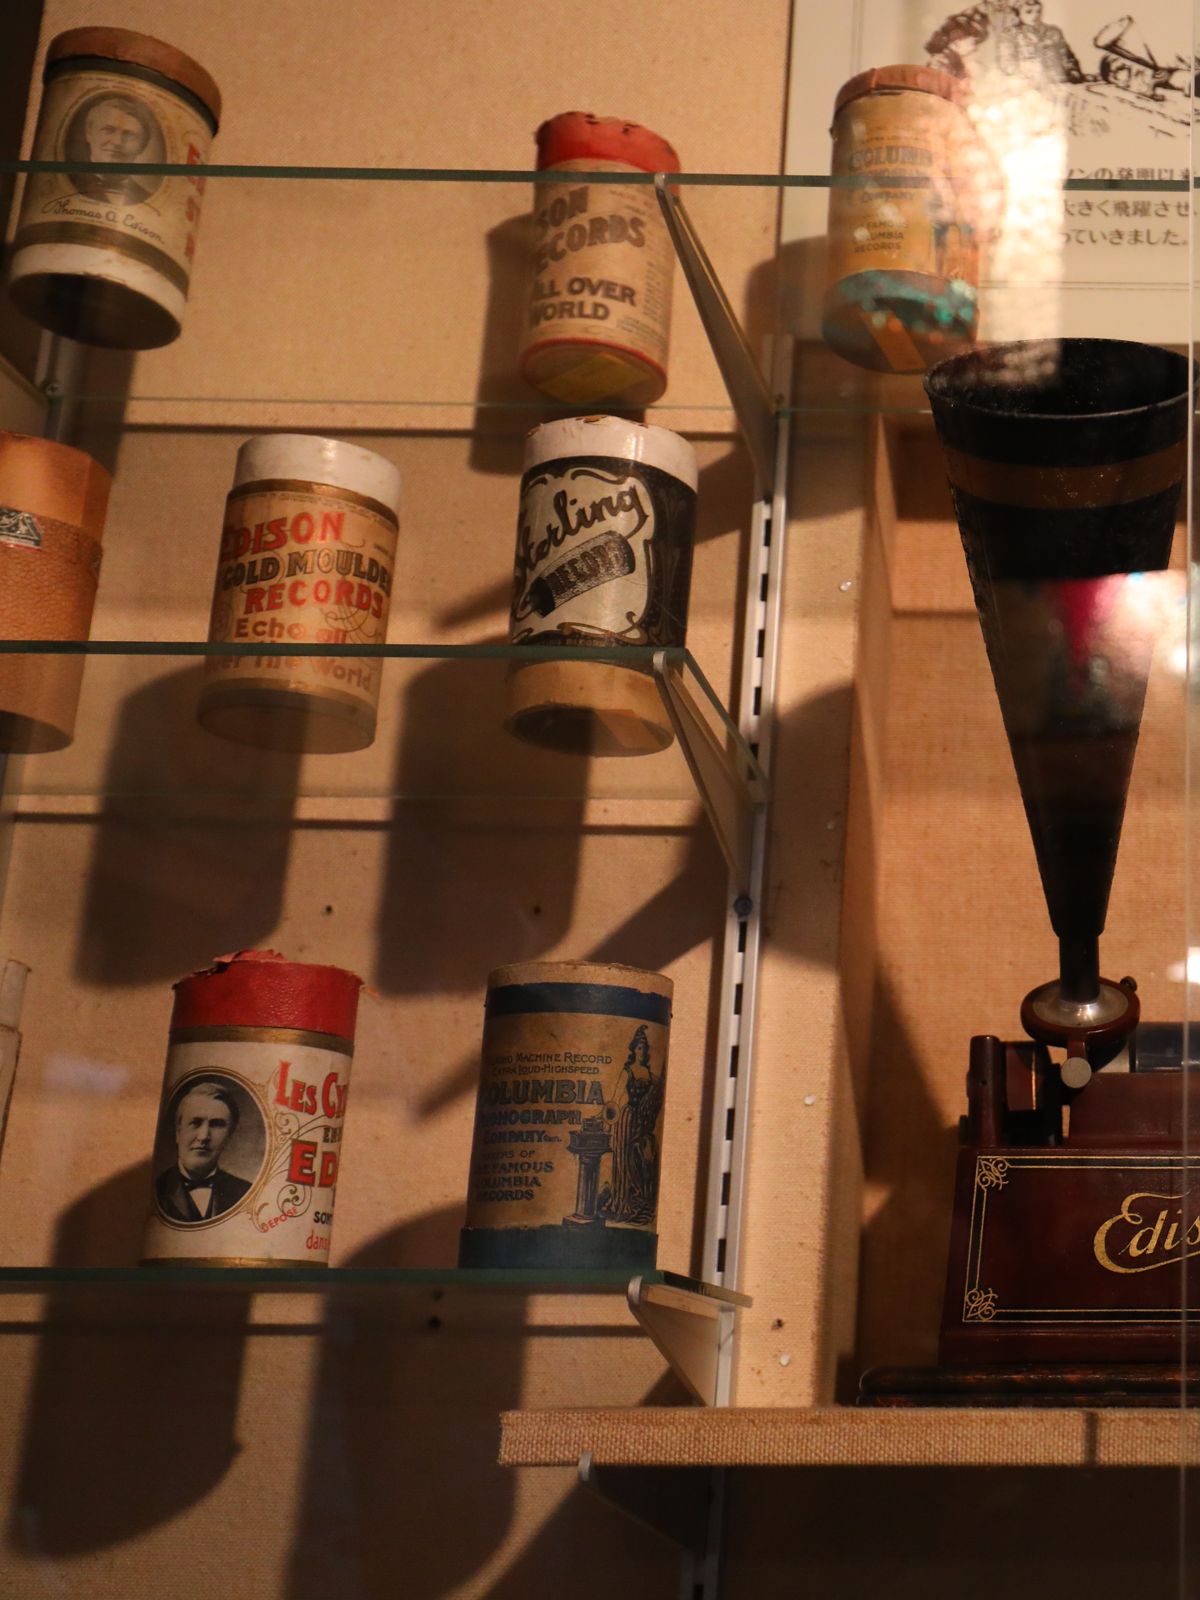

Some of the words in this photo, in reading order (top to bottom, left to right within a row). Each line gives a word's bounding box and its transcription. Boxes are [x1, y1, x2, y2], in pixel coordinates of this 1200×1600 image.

[44, 196, 102, 219] Thomas
[566, 276, 638, 308] OVER
[243, 578, 384, 620] RECORDS
[233, 618, 306, 640] Echo
[563, 1051, 613, 1065] RECORD
